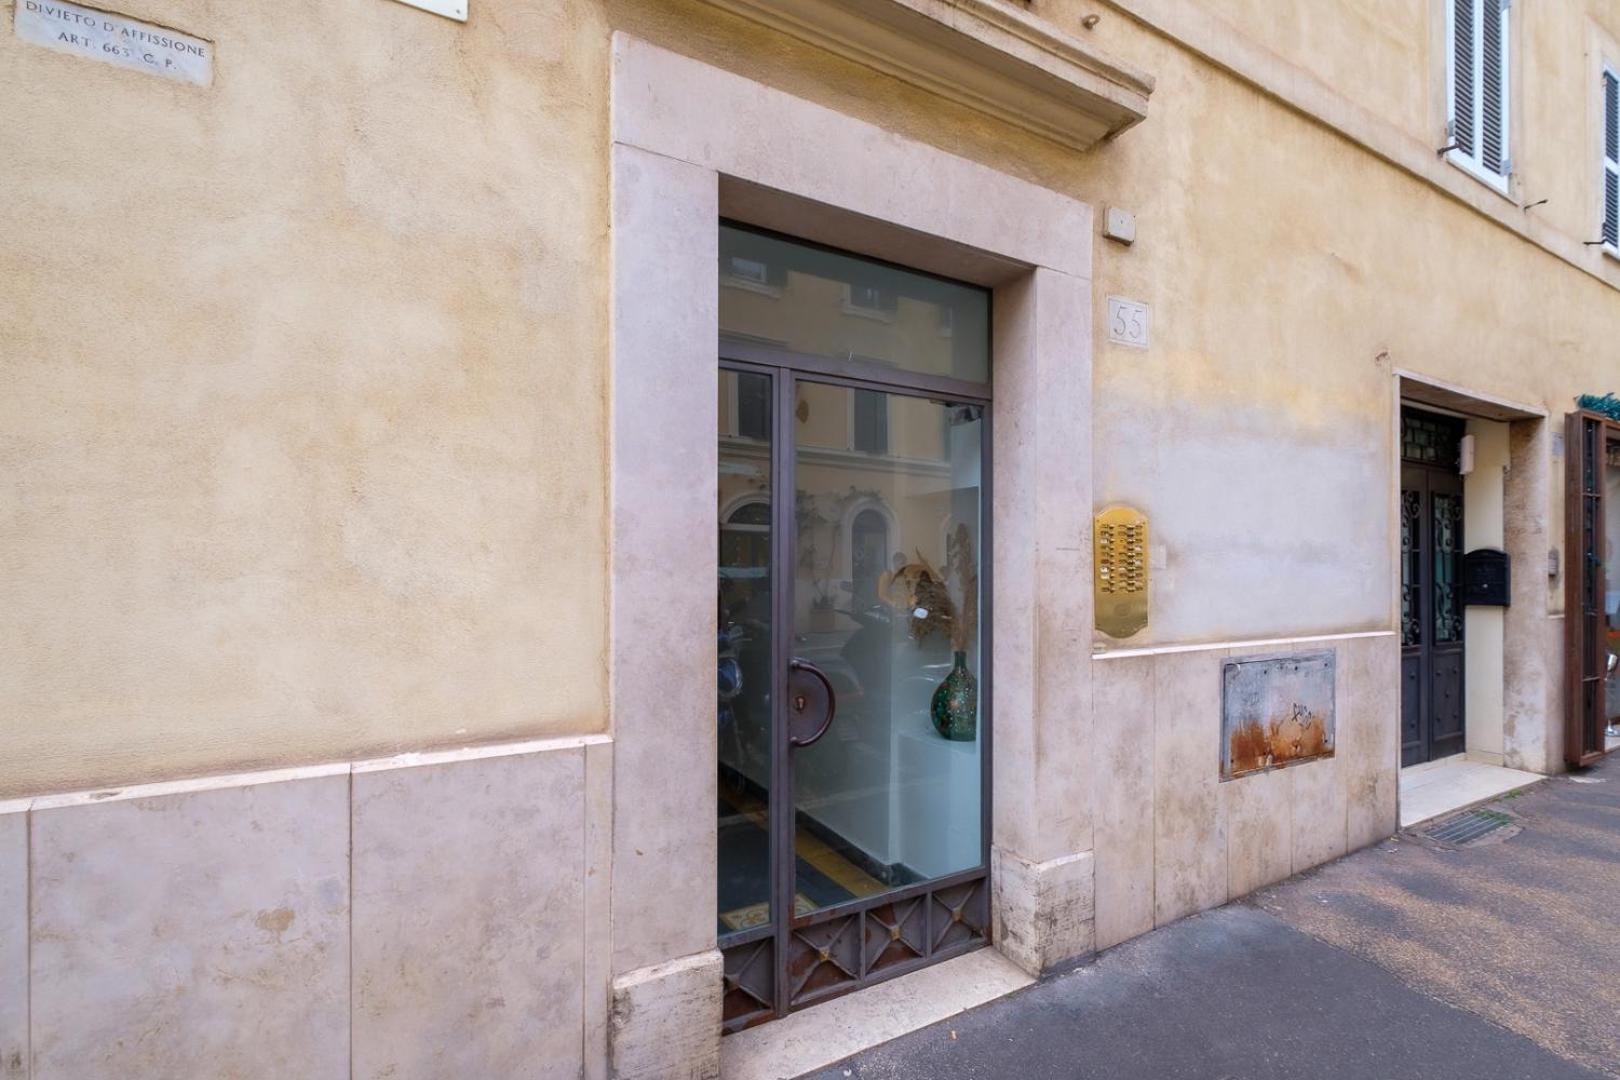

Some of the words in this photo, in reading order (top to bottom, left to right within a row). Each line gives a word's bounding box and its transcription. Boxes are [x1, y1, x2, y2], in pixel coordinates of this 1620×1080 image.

[26, 1, 96, 27] DIVIETO
[102, 43, 130, 57] 663
[1113, 305, 1143, 339] 55
